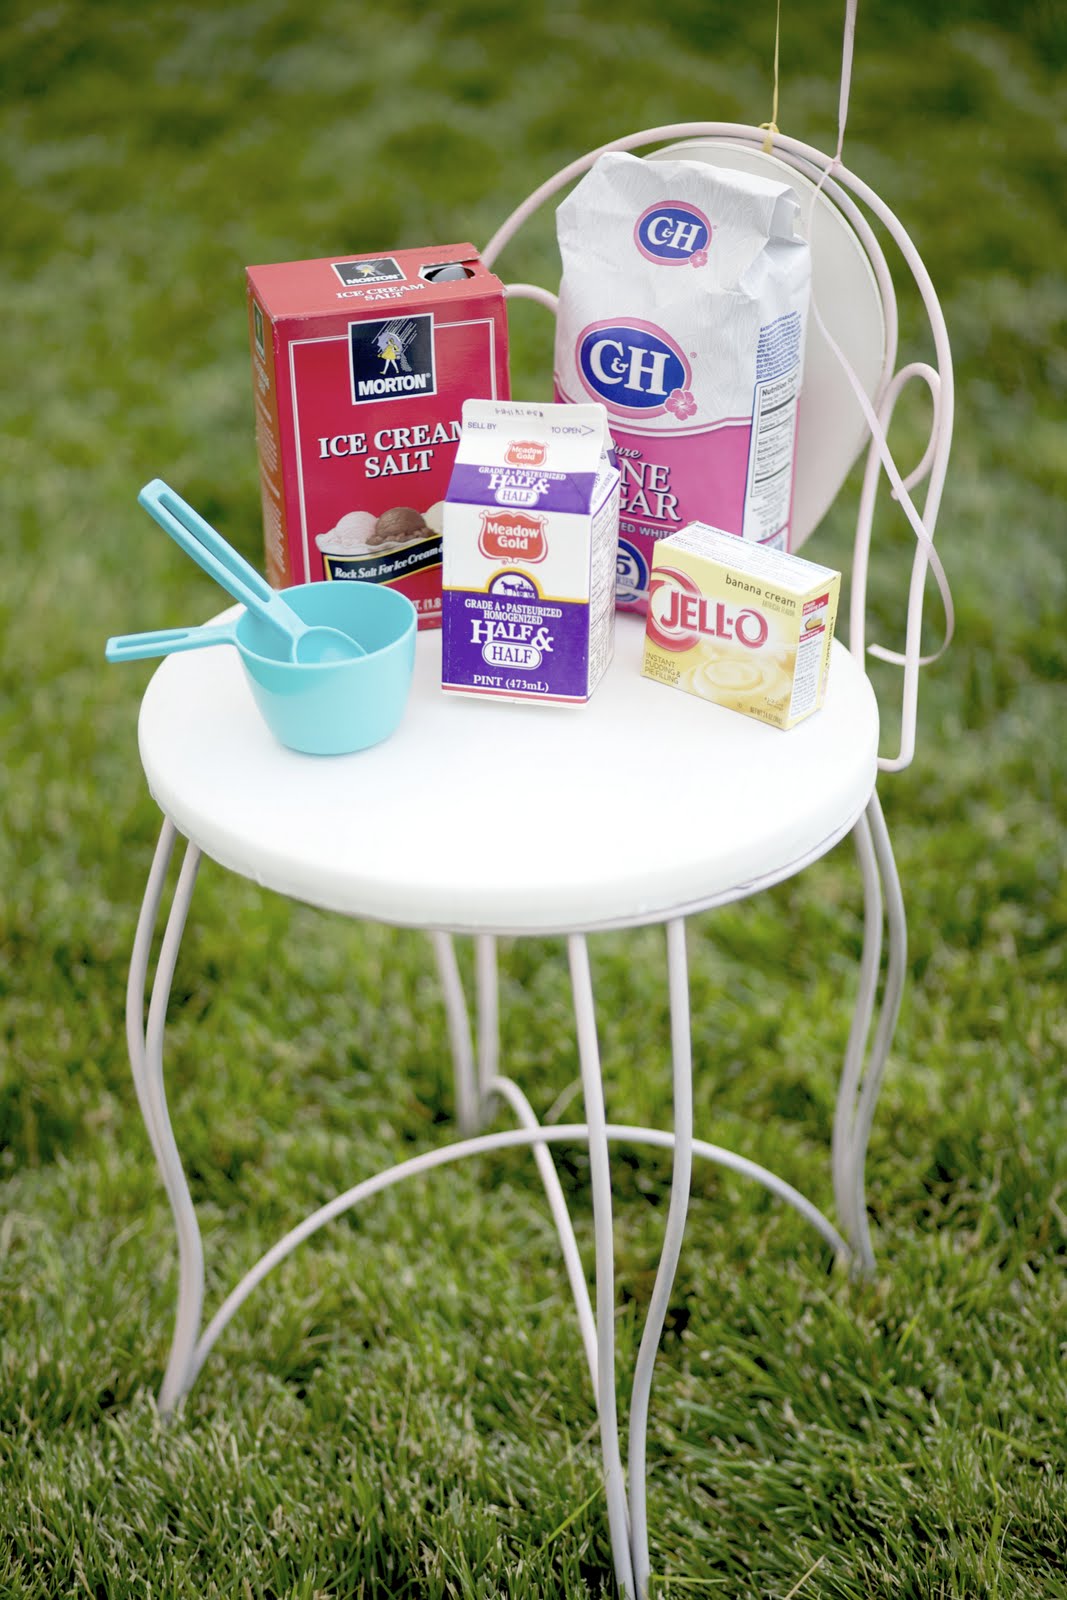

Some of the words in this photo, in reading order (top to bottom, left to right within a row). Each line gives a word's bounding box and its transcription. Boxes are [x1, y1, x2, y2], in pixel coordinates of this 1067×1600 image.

[647, 216, 703, 253] C&H
[336, 290, 365, 299] ICE
[367, 283, 425, 296] CREAM
[364, 291, 404, 301] SALT
[589, 339, 671, 396] C&H
[358, 373, 427, 396] MORTON
[467, 421, 486, 429] SELL
[551, 426, 560, 434] TO
[317, 432, 368, 459] ICE
[512, 446, 543, 454] Meadow
[611, 438, 643, 459] ure
[365, 449, 434, 479] SALT
[516, 452, 536, 460] Gold
[516, 469, 567, 481] PASTEURIZED
[621, 458, 672, 492] NE
[502, 490, 533, 502] HALF
[487, 521, 540, 538] Meadow
[619, 521, 636, 533] ED
[497, 535, 529, 550] Gold
[334, 566, 357, 580] Rock
[358, 566, 378, 579] Salt
[378, 563, 395, 575] For
[394, 559, 408, 572] Ice
[408, 547, 438, 565] Cream
[725, 573, 762, 597] banana
[764, 586, 797, 609] cream
[464, 598, 493, 610] GRADE
[494, 602, 501, 611] A
[506, 603, 563, 618] PASTEURIZED
[483, 610, 543, 625] HOMOGENIZED
[660, 589, 768, 649] JELL-O
[470, 619, 534, 644] HALF
[531, 628, 554, 652] &
[492, 645, 533, 664] HALF
[646, 652, 675, 668] INSTANT
[645, 659, 675, 676] PUDDING
[645, 666, 656, 677] PIE
[655, 670, 679, 684] FILLING
[473, 674, 504, 687] PINT
[505, 678, 550, 693] (473mL)
